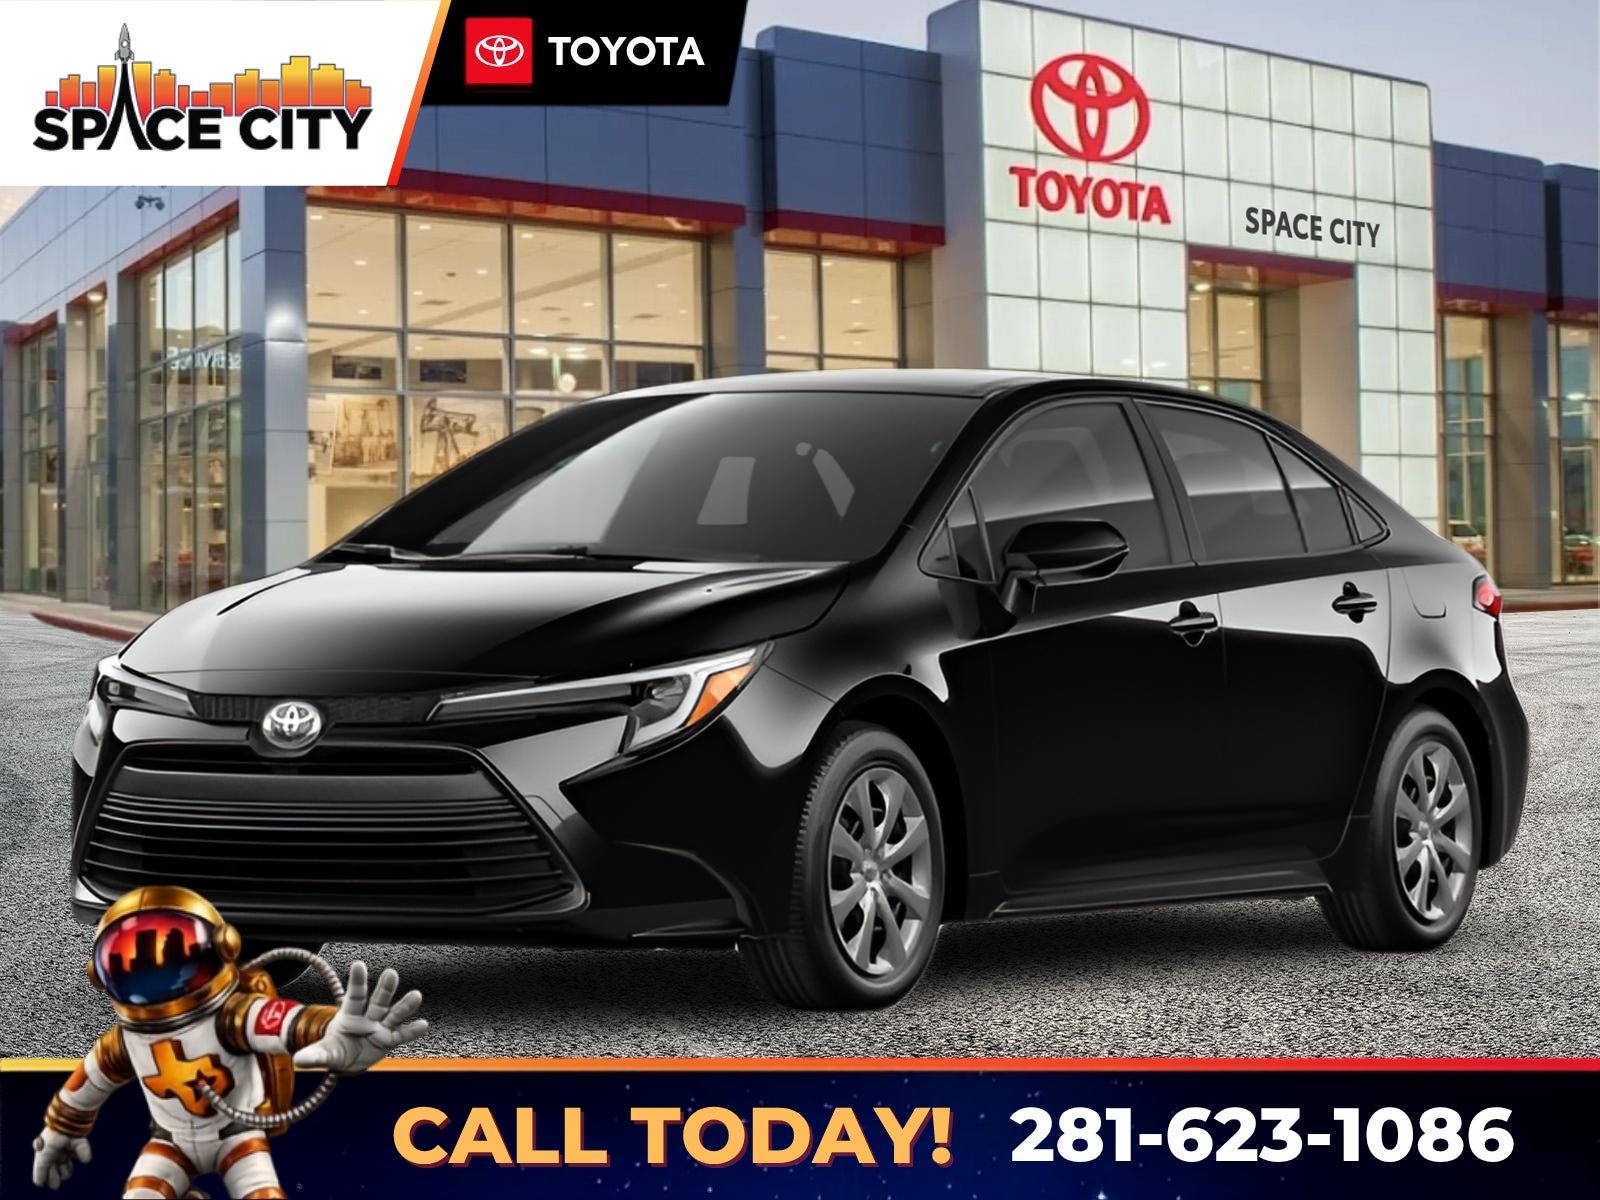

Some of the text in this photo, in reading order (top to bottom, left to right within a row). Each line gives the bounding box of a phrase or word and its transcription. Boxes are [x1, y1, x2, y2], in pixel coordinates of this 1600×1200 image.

[1009, 166, 1171, 224] TOYOTA
[1245, 206, 1381, 248] SPACE CITY
